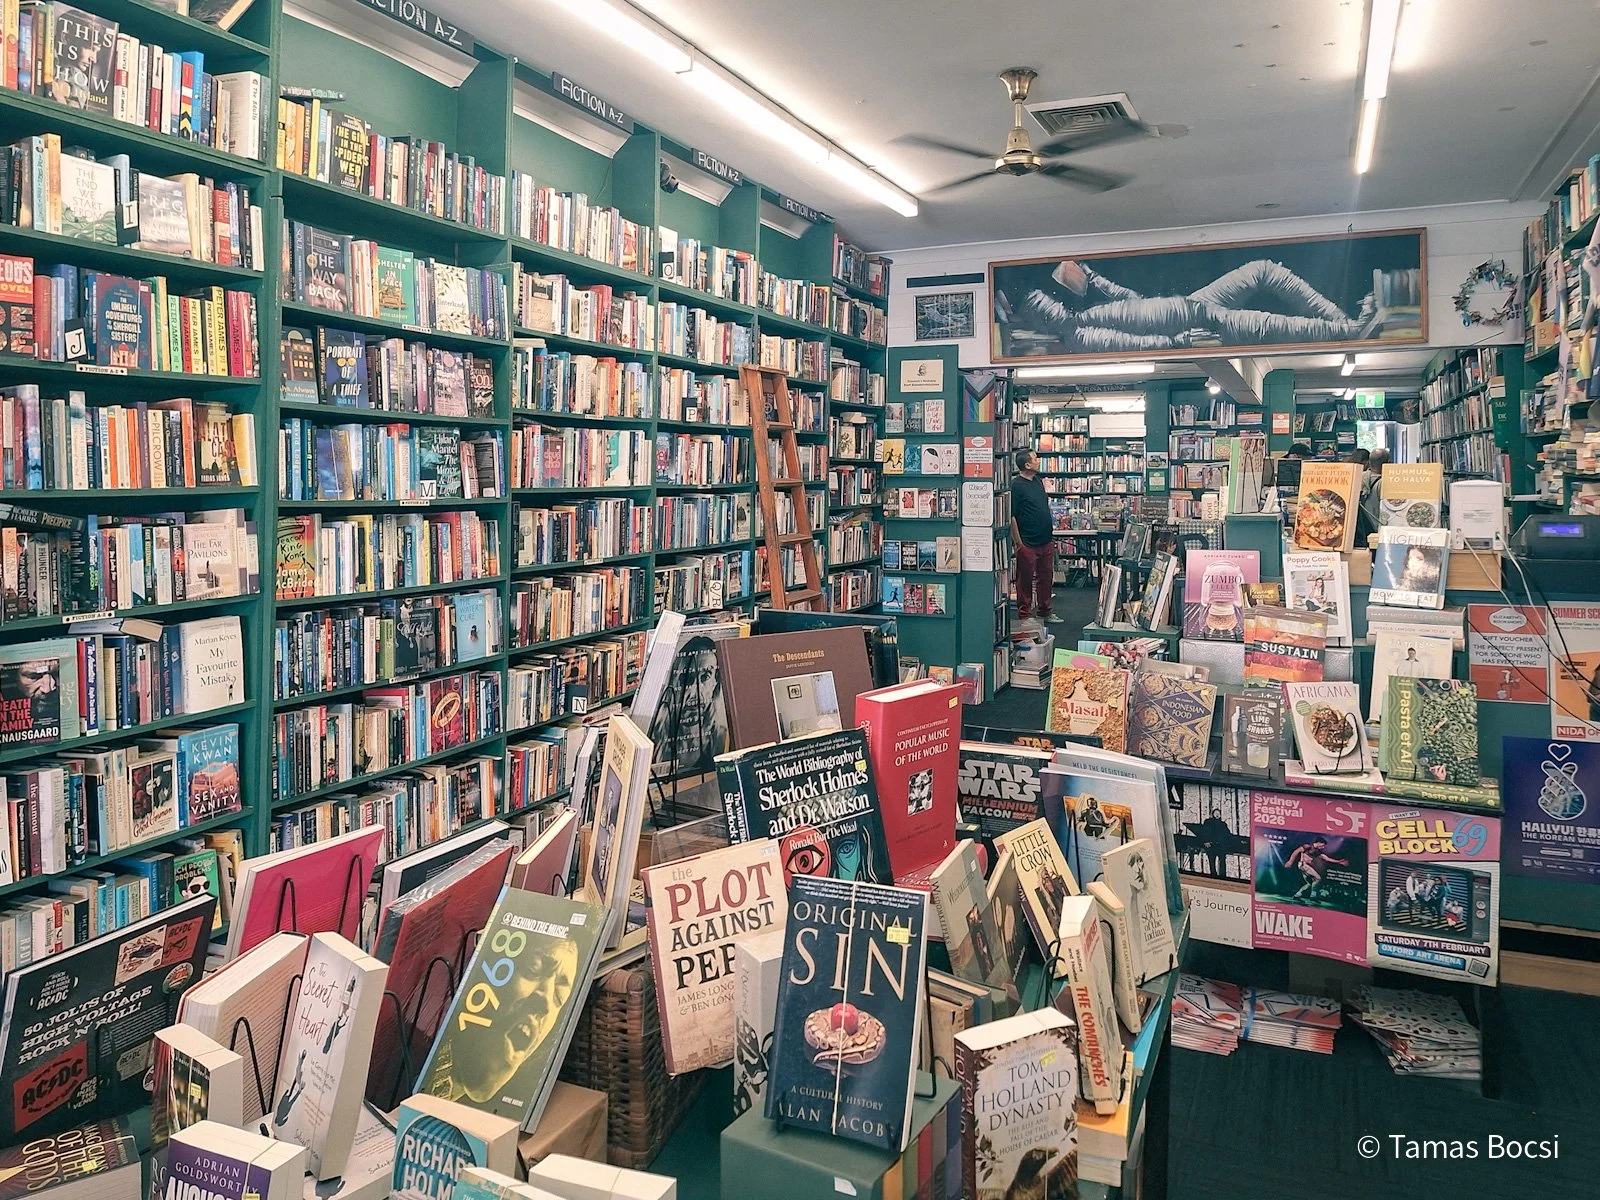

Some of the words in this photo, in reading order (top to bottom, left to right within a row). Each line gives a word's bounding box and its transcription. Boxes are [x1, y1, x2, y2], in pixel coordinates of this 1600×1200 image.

[59, 17, 113, 48] THIS
[434, 17, 462, 45] A-Z
[57, 42, 78, 60] IS
[54, 65, 110, 93] HOW
[561, 78, 606, 118] FICTION
[609, 107, 624, 124] A-Z
[340, 160, 362, 174] WEB
[699, 151, 728, 177] FICTION
[76, 178, 98, 190] END
[786, 199, 809, 218] FICTION
[313, 252, 334, 269] THE
[312, 268, 338, 286] WAY
[386, 269, 396, 278] IN
[308, 284, 341, 301] BACK
[71, 332, 83, 355] J
[111, 331, 137, 342] SISTERS
[172, 321, 180, 352] JAMES
[326, 345, 363, 359] PORTRAIT
[341, 366, 351, 378] OF
[331, 384, 338, 396] A
[340, 383, 362, 396] THIEF
[688, 409, 696, 420] P
[152, 421, 163, 472] PILCROW
[431, 443, 458, 454] Mantel
[420, 482, 435, 498] M
[10, 514, 38, 524] HARRIS
[12, 507, 38, 517] ROBERT
[41, 513, 72, 529] PRECIPICE
[208, 540, 222, 549] FAR
[38, 546, 47, 581] HUNGER
[187, 549, 228, 560] PAVILIONS
[1286, 556, 1310, 564] Poppy
[1311, 555, 1336, 563] Cooks
[1204, 574, 1243, 583] ZUMBO
[459, 605, 479, 614] WATER
[459, 613, 475, 622] CURE
[1553, 607, 1587, 619] SUMMER
[194, 635, 215, 646] Marian
[208, 648, 225, 661] My
[772, 653, 785, 663] The
[785, 649, 825, 662] Descendants
[1260, 641, 1319, 660] SUSTAIN
[195, 660, 238, 675] Favourite
[1293, 685, 1352, 699] AFRICANA
[574, 698, 587, 713] N
[1061, 700, 1112, 718] Masala
[1161, 699, 1206, 715] INDONESIAN
[1171, 708, 1193, 720] FOOD
[1399, 689, 1412, 729] Pasta
[10, 711, 31, 720] THE
[1251, 714, 1271, 724] LIME
[1246, 724, 1275, 735] SHAKER
[1557, 727, 1585, 736] NIDA
[191, 735, 233, 753] KEVIN
[894, 734, 927, 752] POPULAR
[927, 727, 950, 743] MUSIC
[1400, 732, 1412, 748] et
[193, 747, 232, 765] KWAN
[894, 754, 906, 767] OF
[907, 750, 922, 763] THE
[922, 742, 949, 759] WORLD
[755, 769, 776, 784] The
[776, 759, 803, 780] World
[803, 749, 855, 775] Bibliography
[854, 746, 864, 760] of
[957, 759, 1041, 785] STAR
[194, 790, 218, 805] SEX
[219, 786, 234, 794] AND
[758, 775, 818, 812] Sherlock
[818, 768, 869, 793] Holmes
[957, 777, 1041, 803] WARS
[191, 793, 238, 816] VANITY
[962, 796, 1039, 813] MILLENNIUM
[1254, 793, 1300, 810] Sydney
[1254, 802, 1303, 818] Festival
[724, 791, 738, 839] Sherlock
[768, 806, 796, 837] and
[798, 803, 821, 826] Dr.
[822, 793, 870, 819] Watson
[962, 805, 1012, 819] FALCON
[1254, 813, 1285, 826] 2026
[1376, 820, 1454, 840] CELL
[1521, 821, 1574, 836] HALLYU!
[1522, 832, 1538, 840] THE
[1540, 834, 1575, 842] KOREAN
[789, 831, 814, 851] Ronald
[1011, 829, 1048, 857] LITTLE
[1378, 839, 1459, 856] BLOCK
[1020, 844, 1053, 873] CROW
[672, 867, 693, 882] the
[664, 861, 772, 925] PLOT
[1203, 898, 1249, 916] Journey
[511, 914, 536, 931] BEHIND
[536, 919, 550, 933] THE
[549, 923, 570, 938] MUSIC
[670, 901, 775, 953] AGAINST
[793, 900, 918, 938] ORIGINAL
[1255, 911, 1314, 940] WAKE
[1377, 935, 1422, 947] SATURDAY
[1423, 940, 1440, 949] 7TH
[1440, 942, 1487, 955] FEBRUARY
[789, 927, 912, 1001] SIN
[1381, 944, 1415, 956] OXFORD
[1415, 950, 1433, 959] ART
[1433, 954, 1462, 966] ARENA
[303, 966, 339, 1009] Secret
[456, 928, 527, 1032] 1968
[677, 990, 707, 1006] JAMES
[1076, 986, 1091, 1009] THE
[20, 985, 153, 1051] HIGH-VOLTAGE
[23, 1021, 44, 1037] 50
[46, 996, 100, 1026] JOLTS
[101, 985, 126, 1001] OF
[18, 1034, 71, 1065] ROCK
[94, 1001, 142, 1030] ROLL!
[298, 1002, 328, 1047] Heart
[1081, 1011, 1108, 1088] COMANCHES
[1007, 1061, 1043, 1083] TOM
[791, 1085, 797, 1094] A
[845, 1095, 884, 1112] HISTORY
[963, 1078, 974, 1115] TOM
[981, 1069, 1071, 1113] HOLLAND
[989, 1090, 1066, 1132] DYNASTY
[1000, 1142, 1022, 1155] HOUSE
[1033, 1128, 1059, 1144] CAESAR
[22, 1138, 62, 1192] GODS
[194, 1156, 240, 1178] ADRIAN
